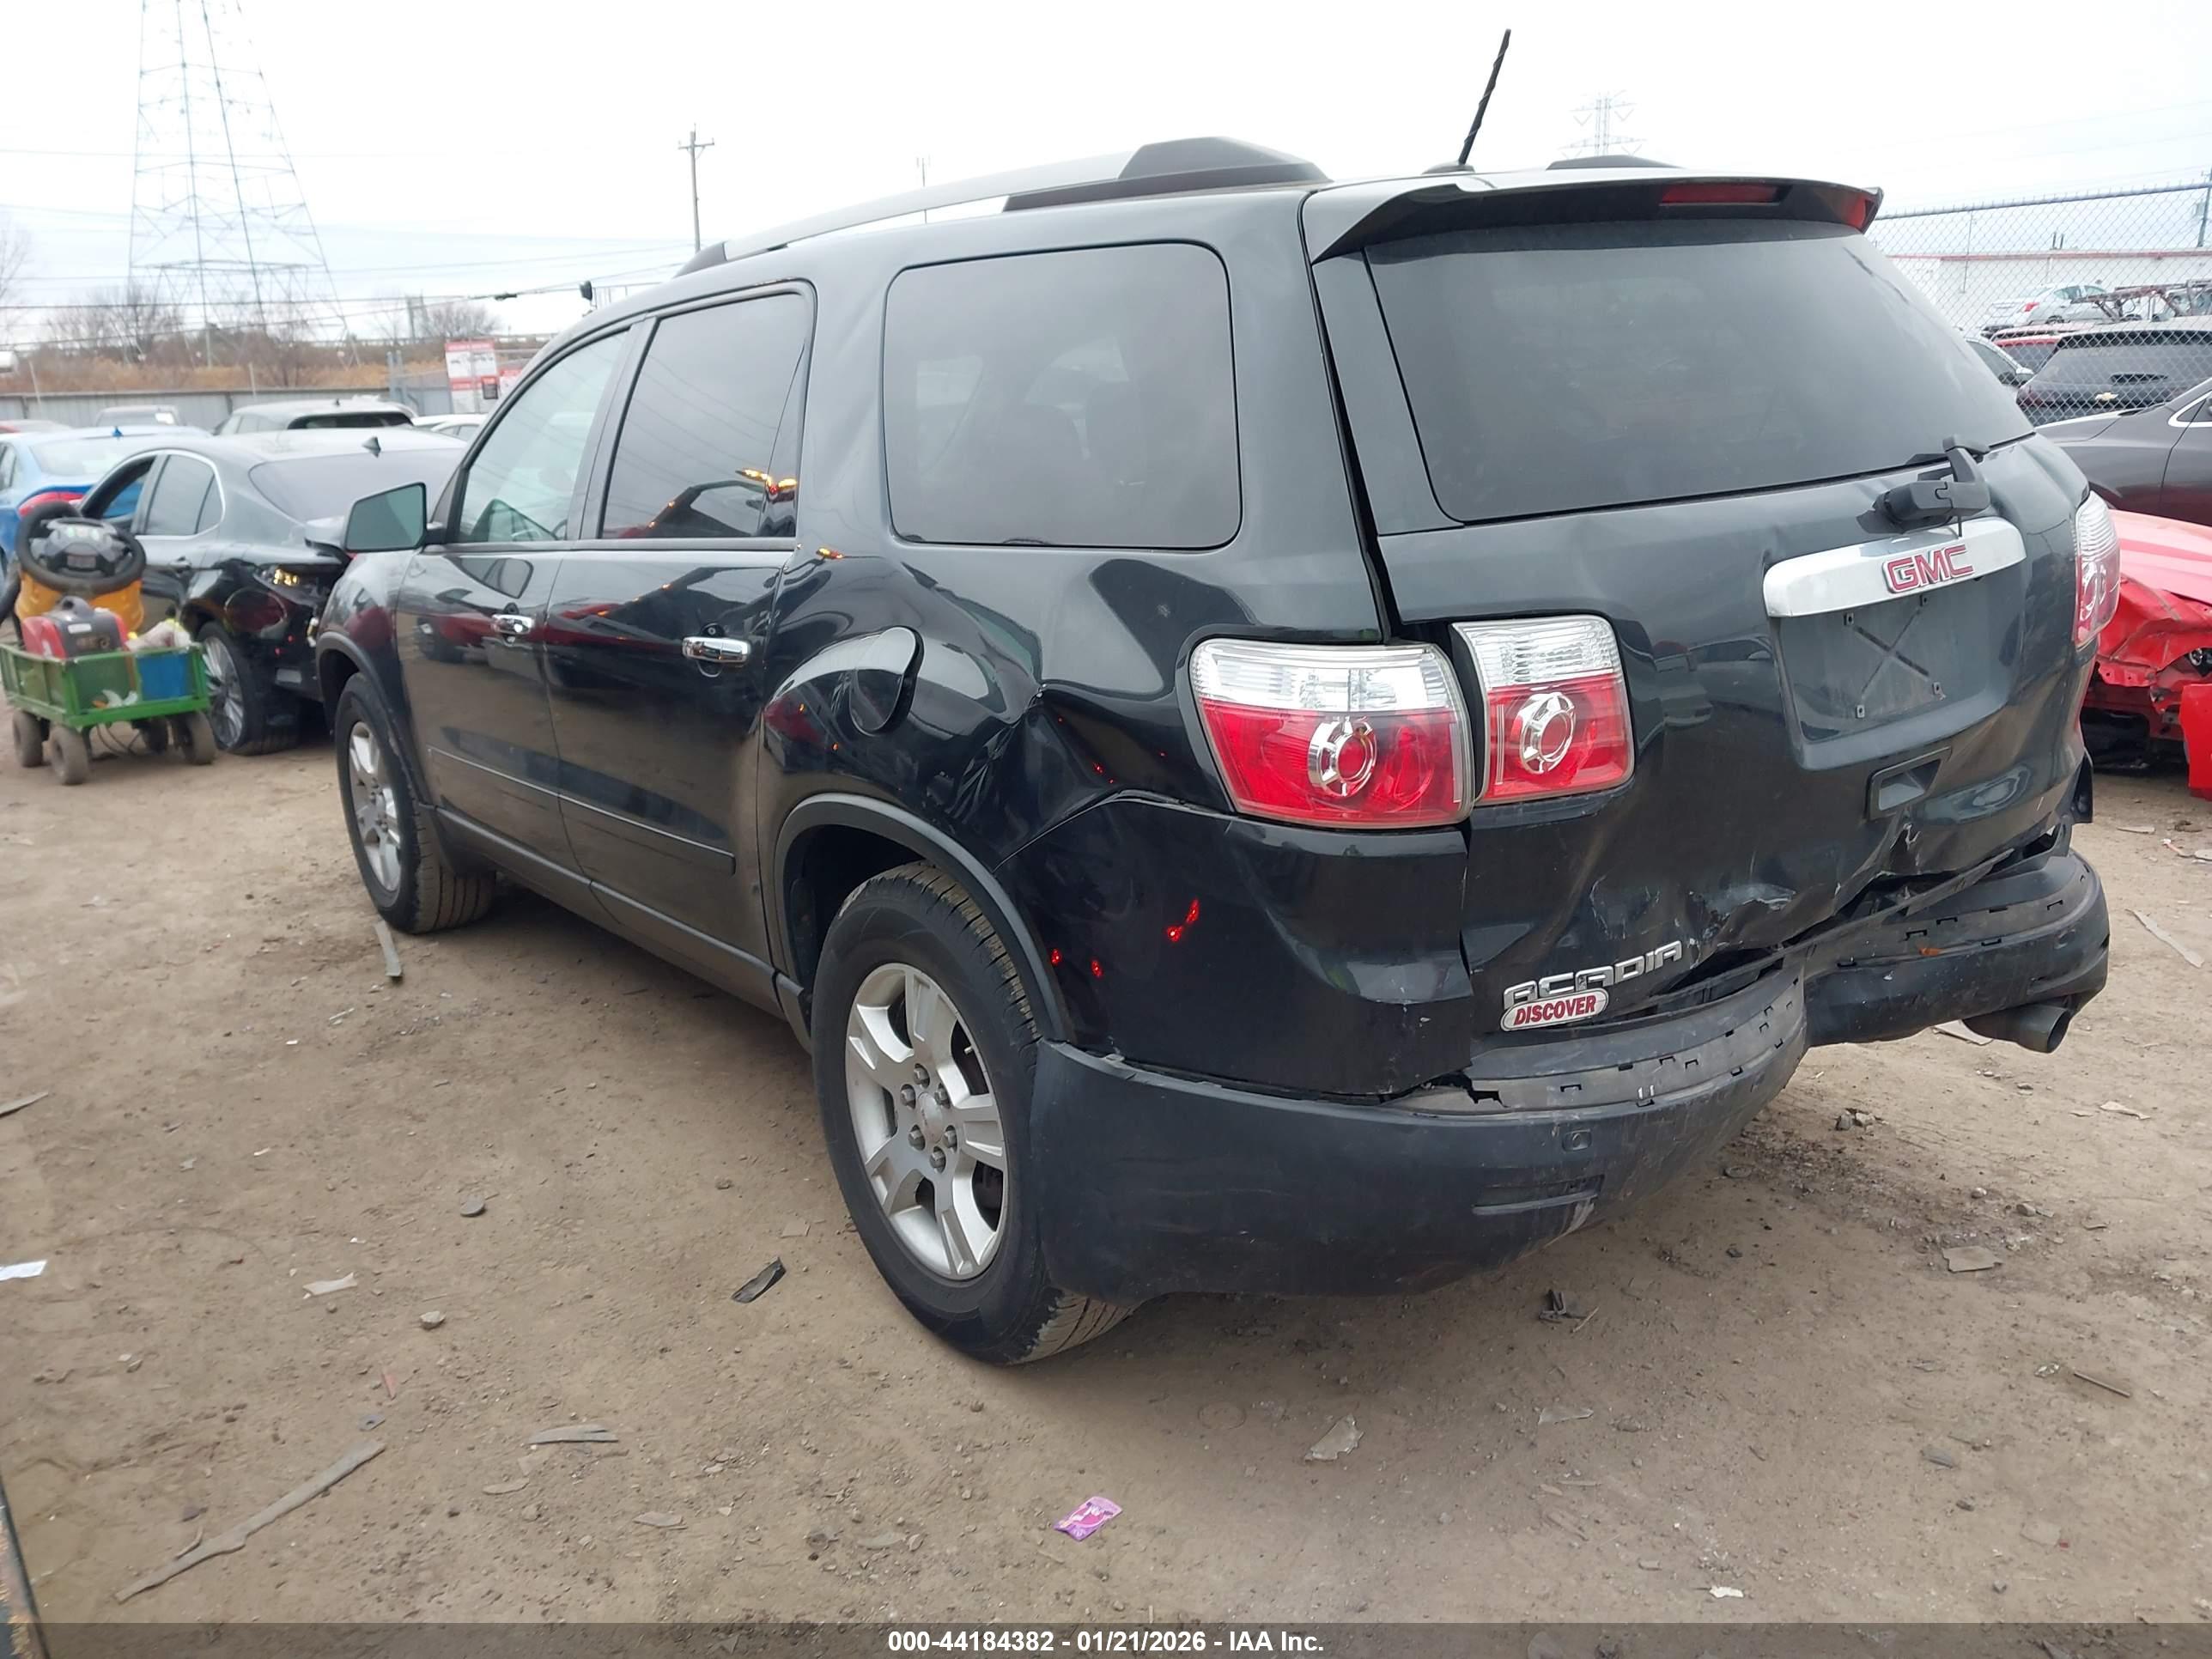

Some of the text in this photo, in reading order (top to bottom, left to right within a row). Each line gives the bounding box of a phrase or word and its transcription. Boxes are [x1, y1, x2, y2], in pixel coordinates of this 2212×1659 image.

[1884, 544, 1974, 592] GMC
[1504, 940, 1682, 1010] ACADIA
[1513, 994, 1597, 1026] DISCOVER
